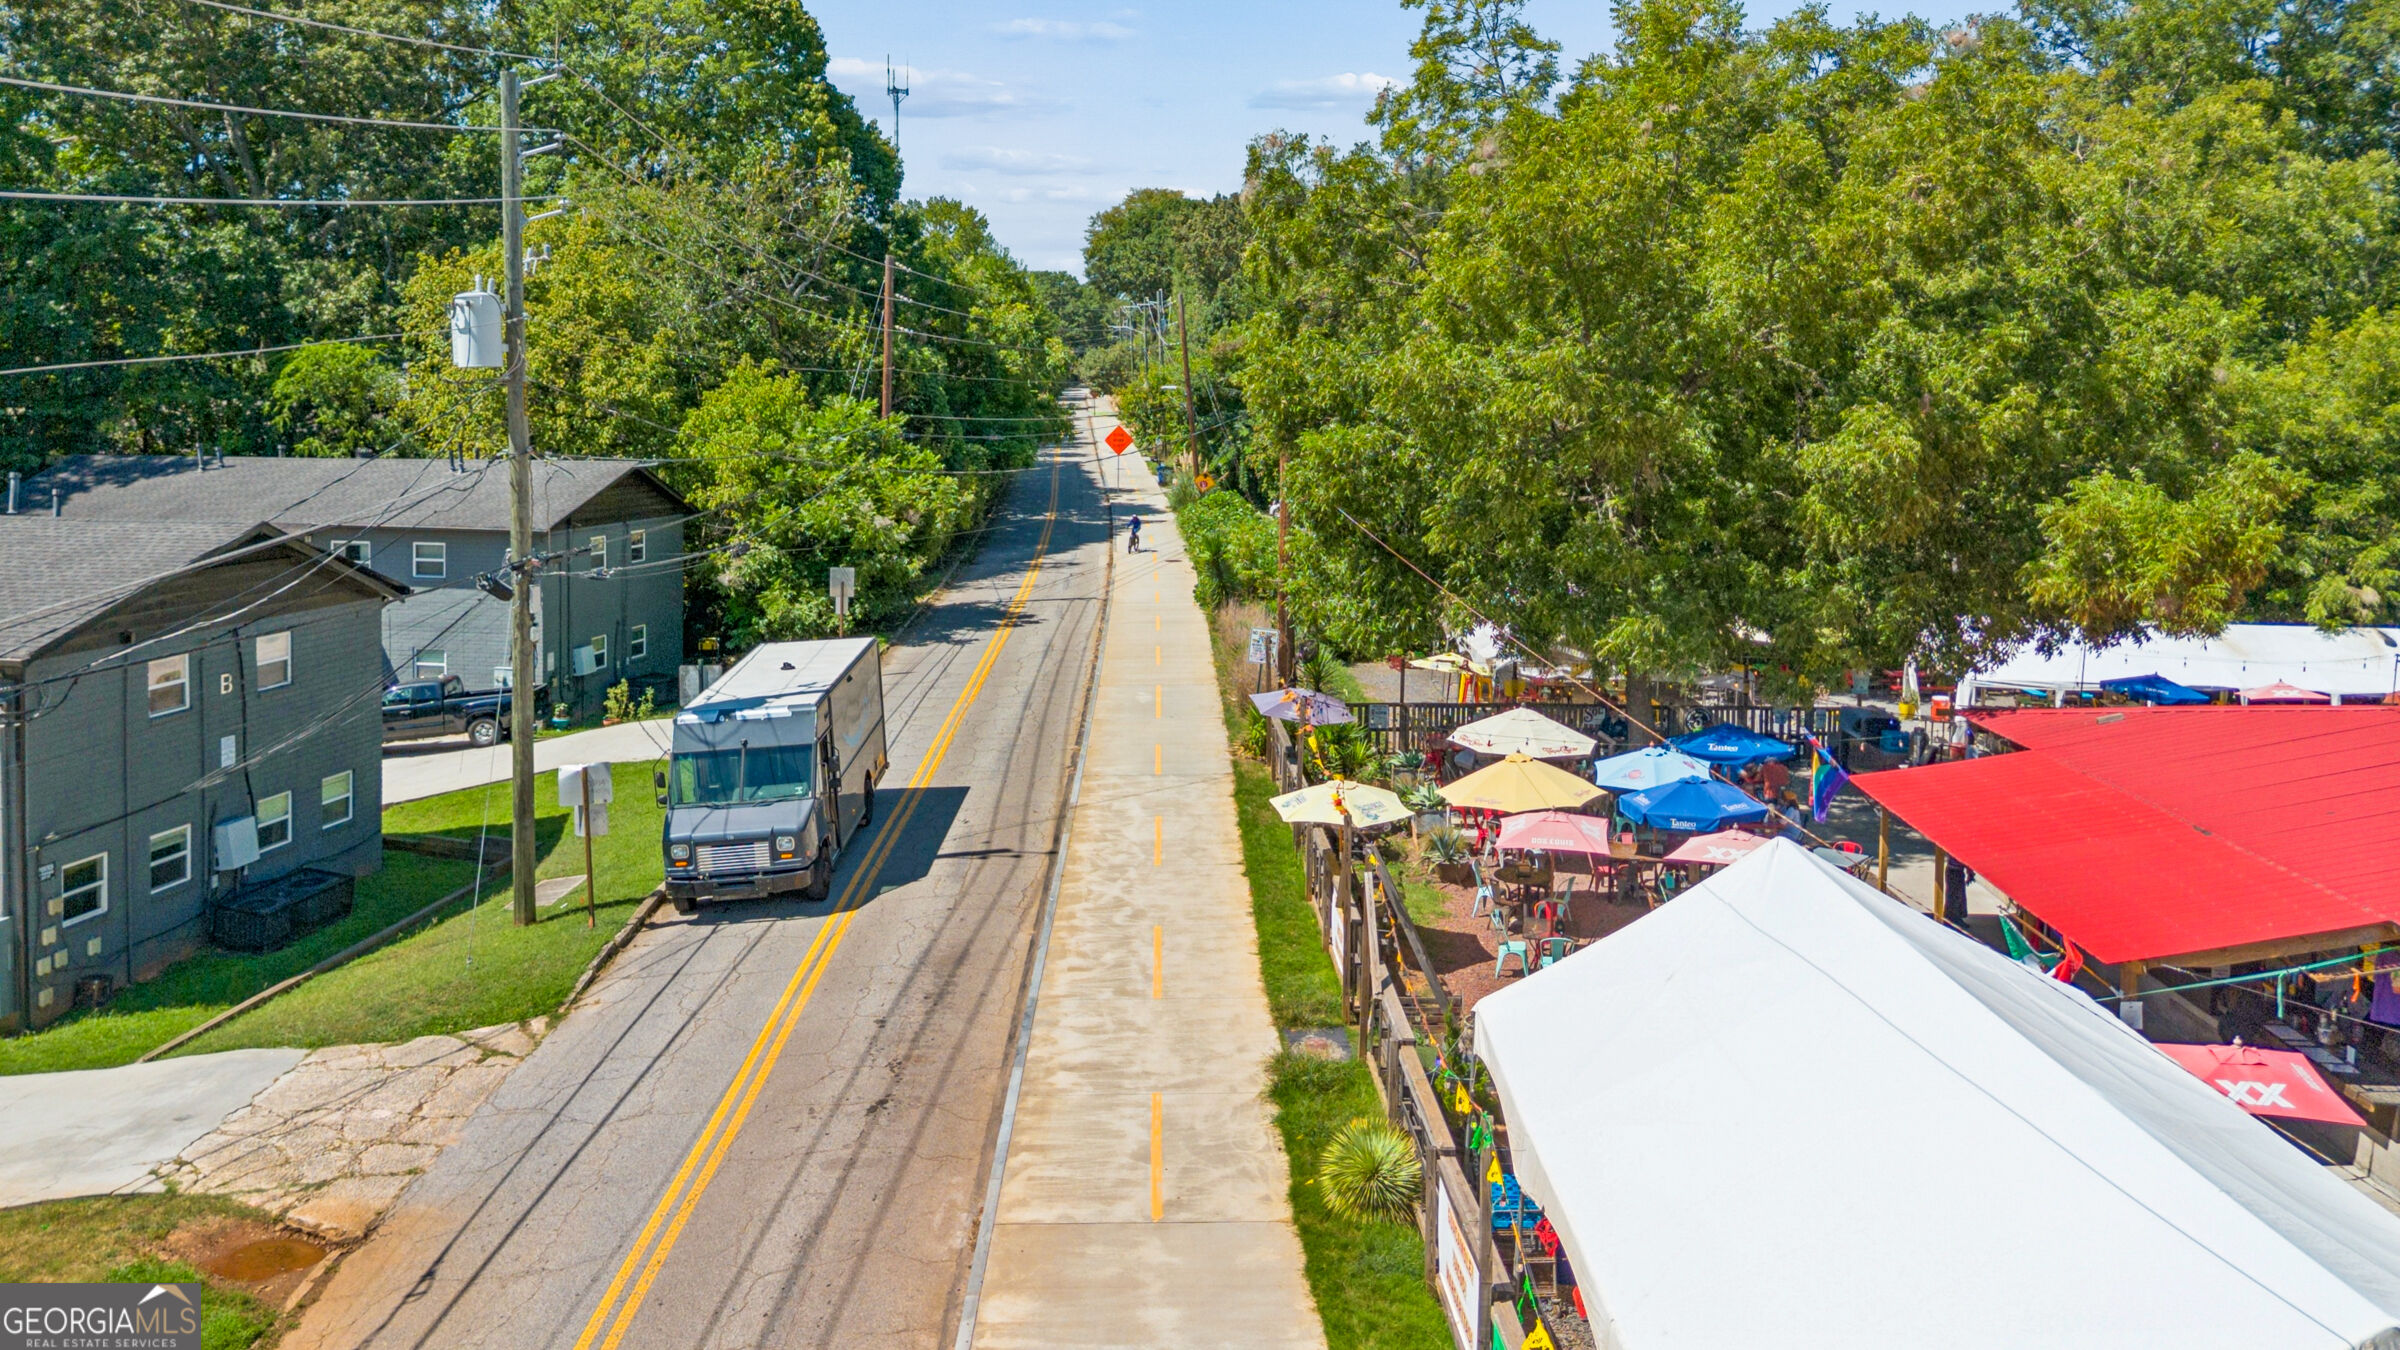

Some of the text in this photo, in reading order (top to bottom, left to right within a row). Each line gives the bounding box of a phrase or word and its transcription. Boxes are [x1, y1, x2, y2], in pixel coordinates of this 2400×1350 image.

[220, 673, 233, 695] B
[1707, 742, 1739, 752] Tanteo
[1670, 818, 1696, 827] Tanteo
[2214, 1079, 2296, 1109] XX
